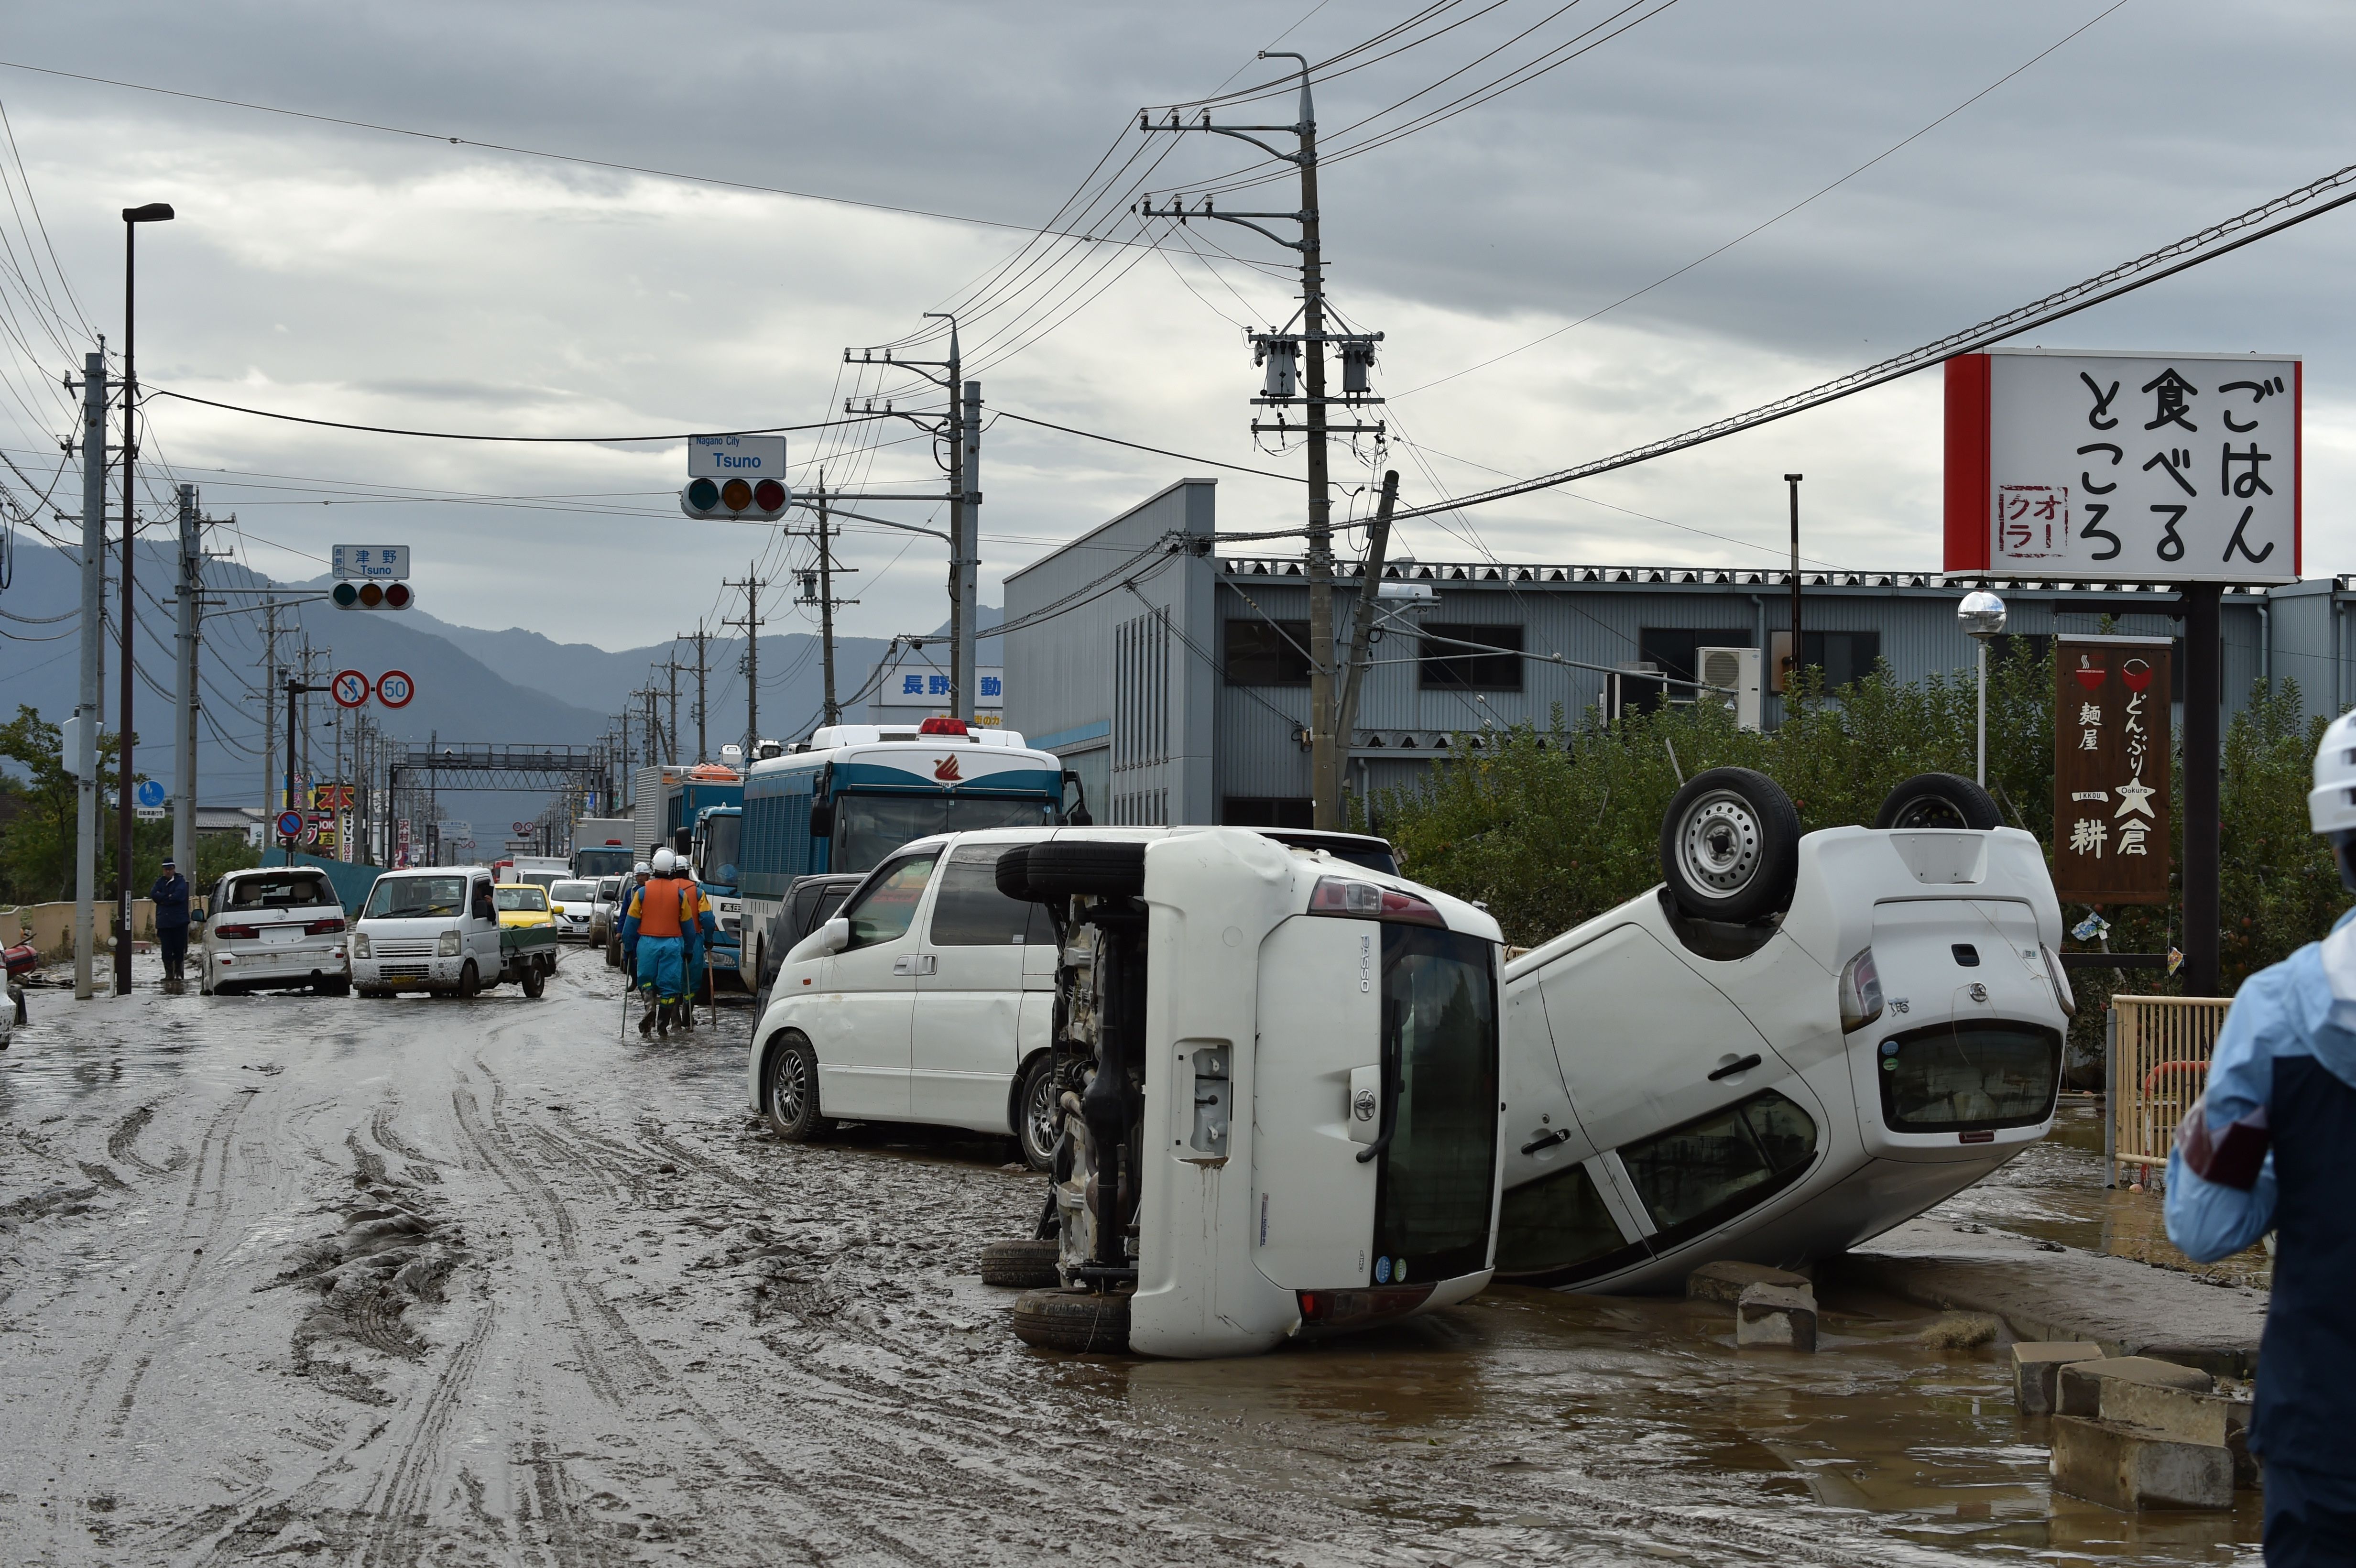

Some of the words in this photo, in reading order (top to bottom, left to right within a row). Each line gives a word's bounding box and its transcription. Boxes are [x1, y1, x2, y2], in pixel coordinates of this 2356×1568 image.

[696, 436, 723, 446] Nagano
[726, 436, 740, 447] City
[713, 453, 761, 468] Tsuno
[2077, 371, 2123, 561] ところ
[2141, 367, 2198, 562] 食べる
[2218, 376, 2284, 564] ごはん
[360, 565, 392, 575] Tsuno
[384, 681, 406, 697] 50
[903, 675, 1001, 697] 長野動
[2078, 702, 2103, 751] 麺屋
[2125, 691, 2148, 777] どんぶり
[1360, 934, 1370, 993] PASSO
